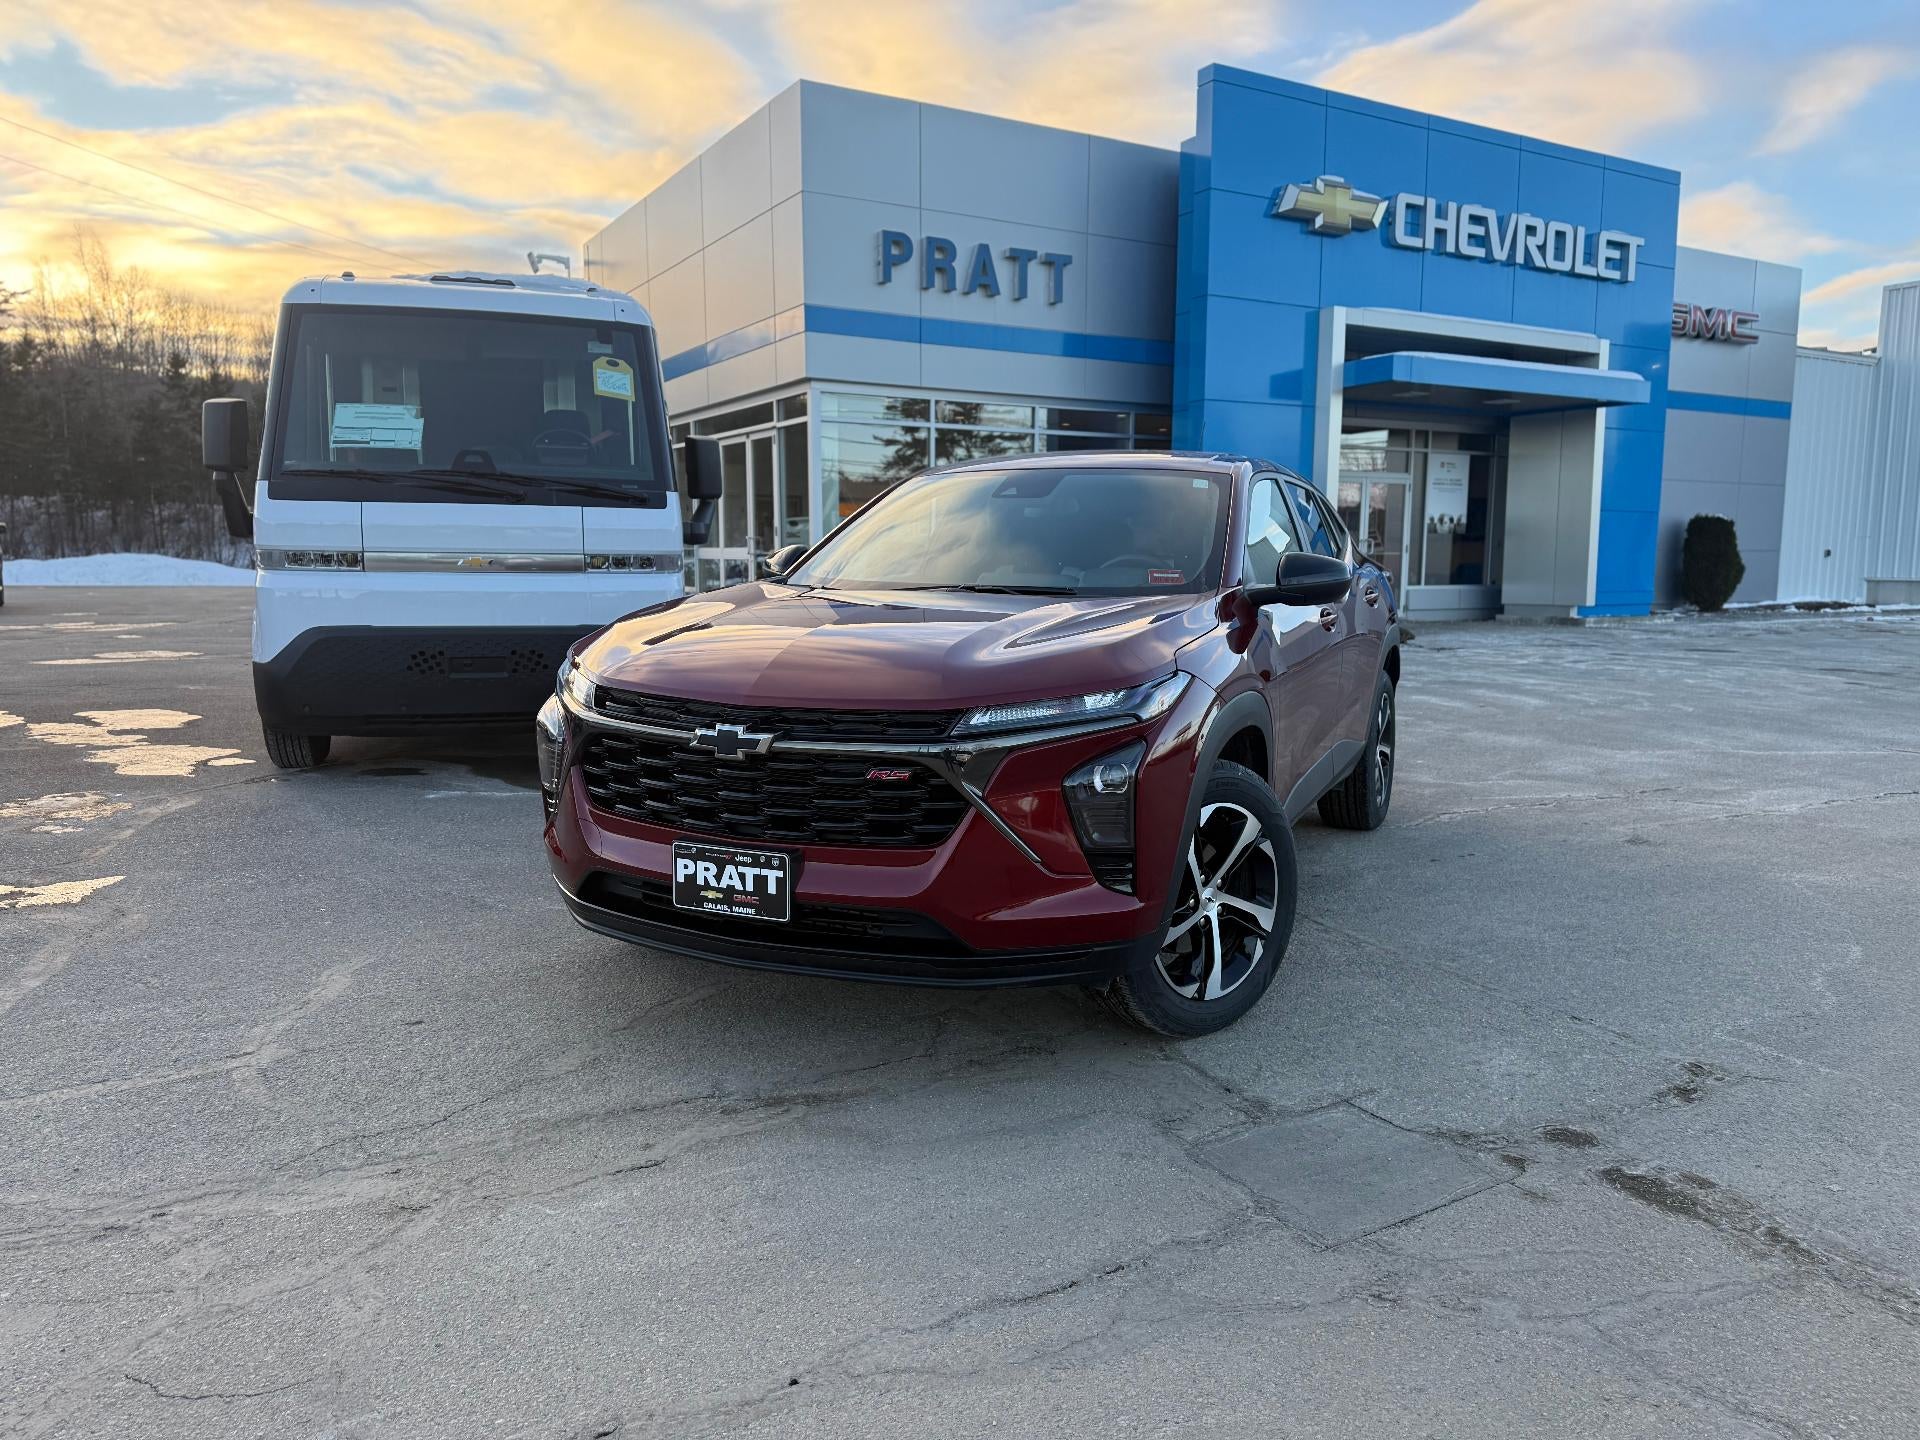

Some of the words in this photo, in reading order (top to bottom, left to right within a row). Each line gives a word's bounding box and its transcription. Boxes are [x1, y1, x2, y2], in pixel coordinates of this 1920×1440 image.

[1394, 192, 1645, 282] CHEVROLET
[876, 229, 1073, 306] PRATT
[1672, 302, 1760, 344] GMC
[866, 769, 912, 782] RS
[735, 853, 752, 864] Jeep
[676, 857, 784, 895] PRATT
[703, 901, 731, 912] CALAIS,
[732, 905, 756, 915] MAINE
[733, 894, 760, 905] GMC
